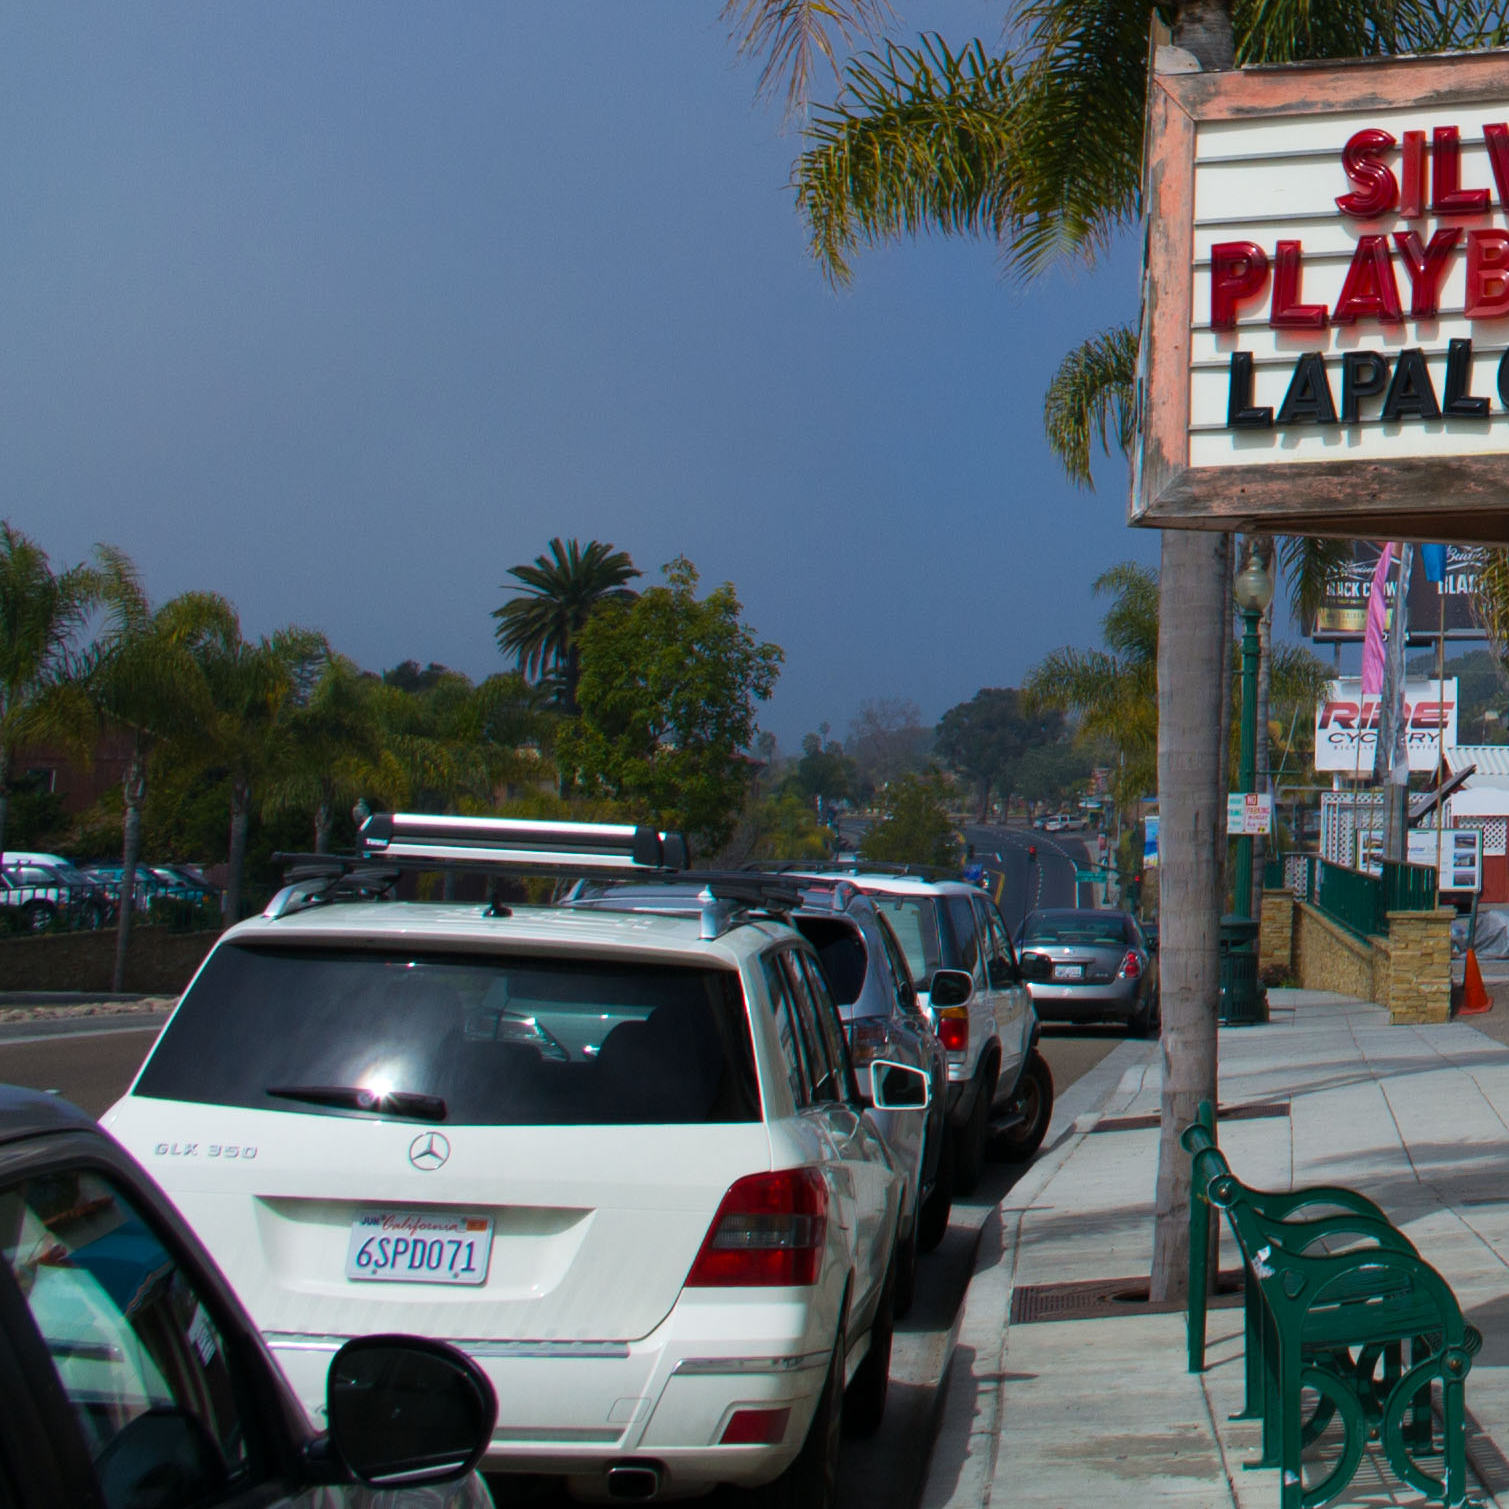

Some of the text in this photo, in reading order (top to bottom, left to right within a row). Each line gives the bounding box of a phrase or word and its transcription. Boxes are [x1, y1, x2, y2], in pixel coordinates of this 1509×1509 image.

[1328, 732, 1439, 743] CYCRY
[154, 1142, 258, 1160] GLK 350
[381, 1214, 460, 1236] California
[356, 1236, 476, 1273] 6SPD071
